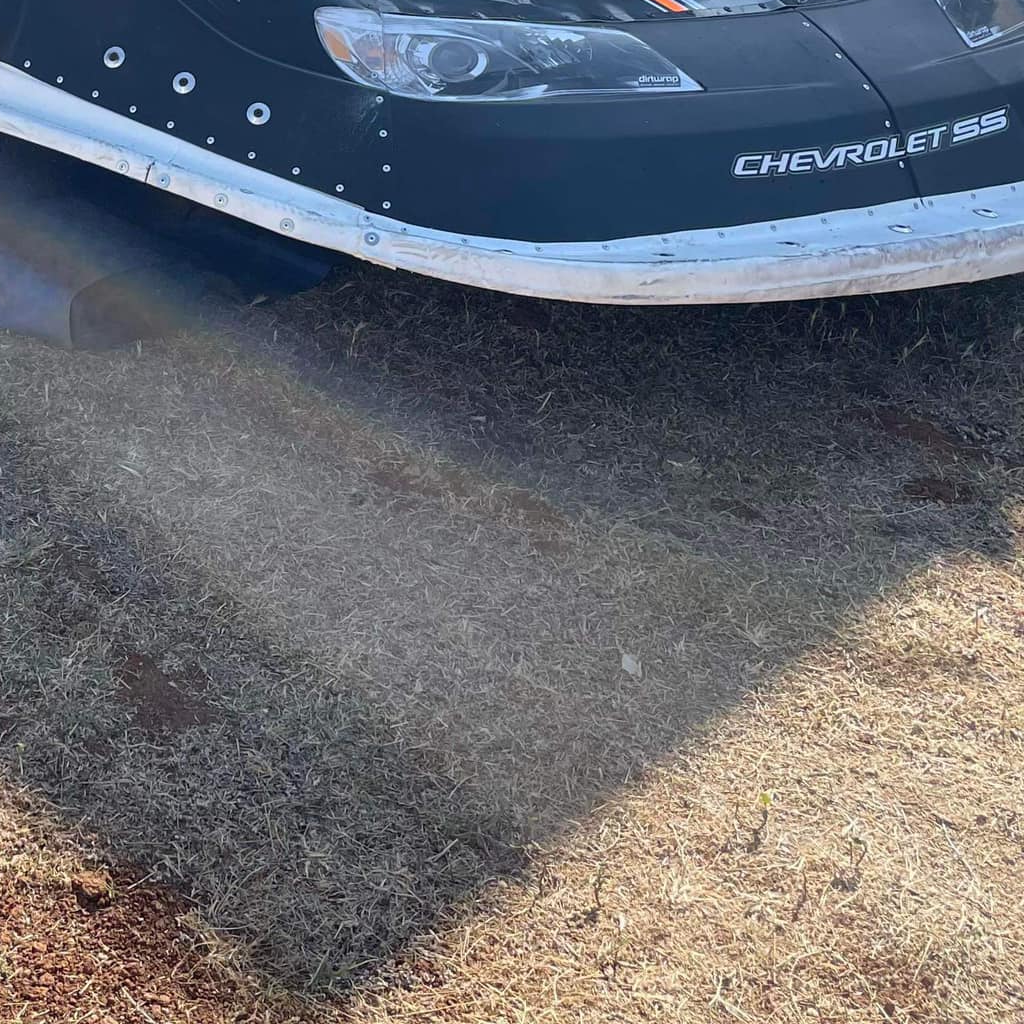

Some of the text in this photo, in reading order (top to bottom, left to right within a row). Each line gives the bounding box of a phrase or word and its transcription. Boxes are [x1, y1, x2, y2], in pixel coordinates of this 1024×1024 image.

[638, 75, 679, 83] dirtwrap
[734, 108, 1008, 176] CHEVROLET SS
